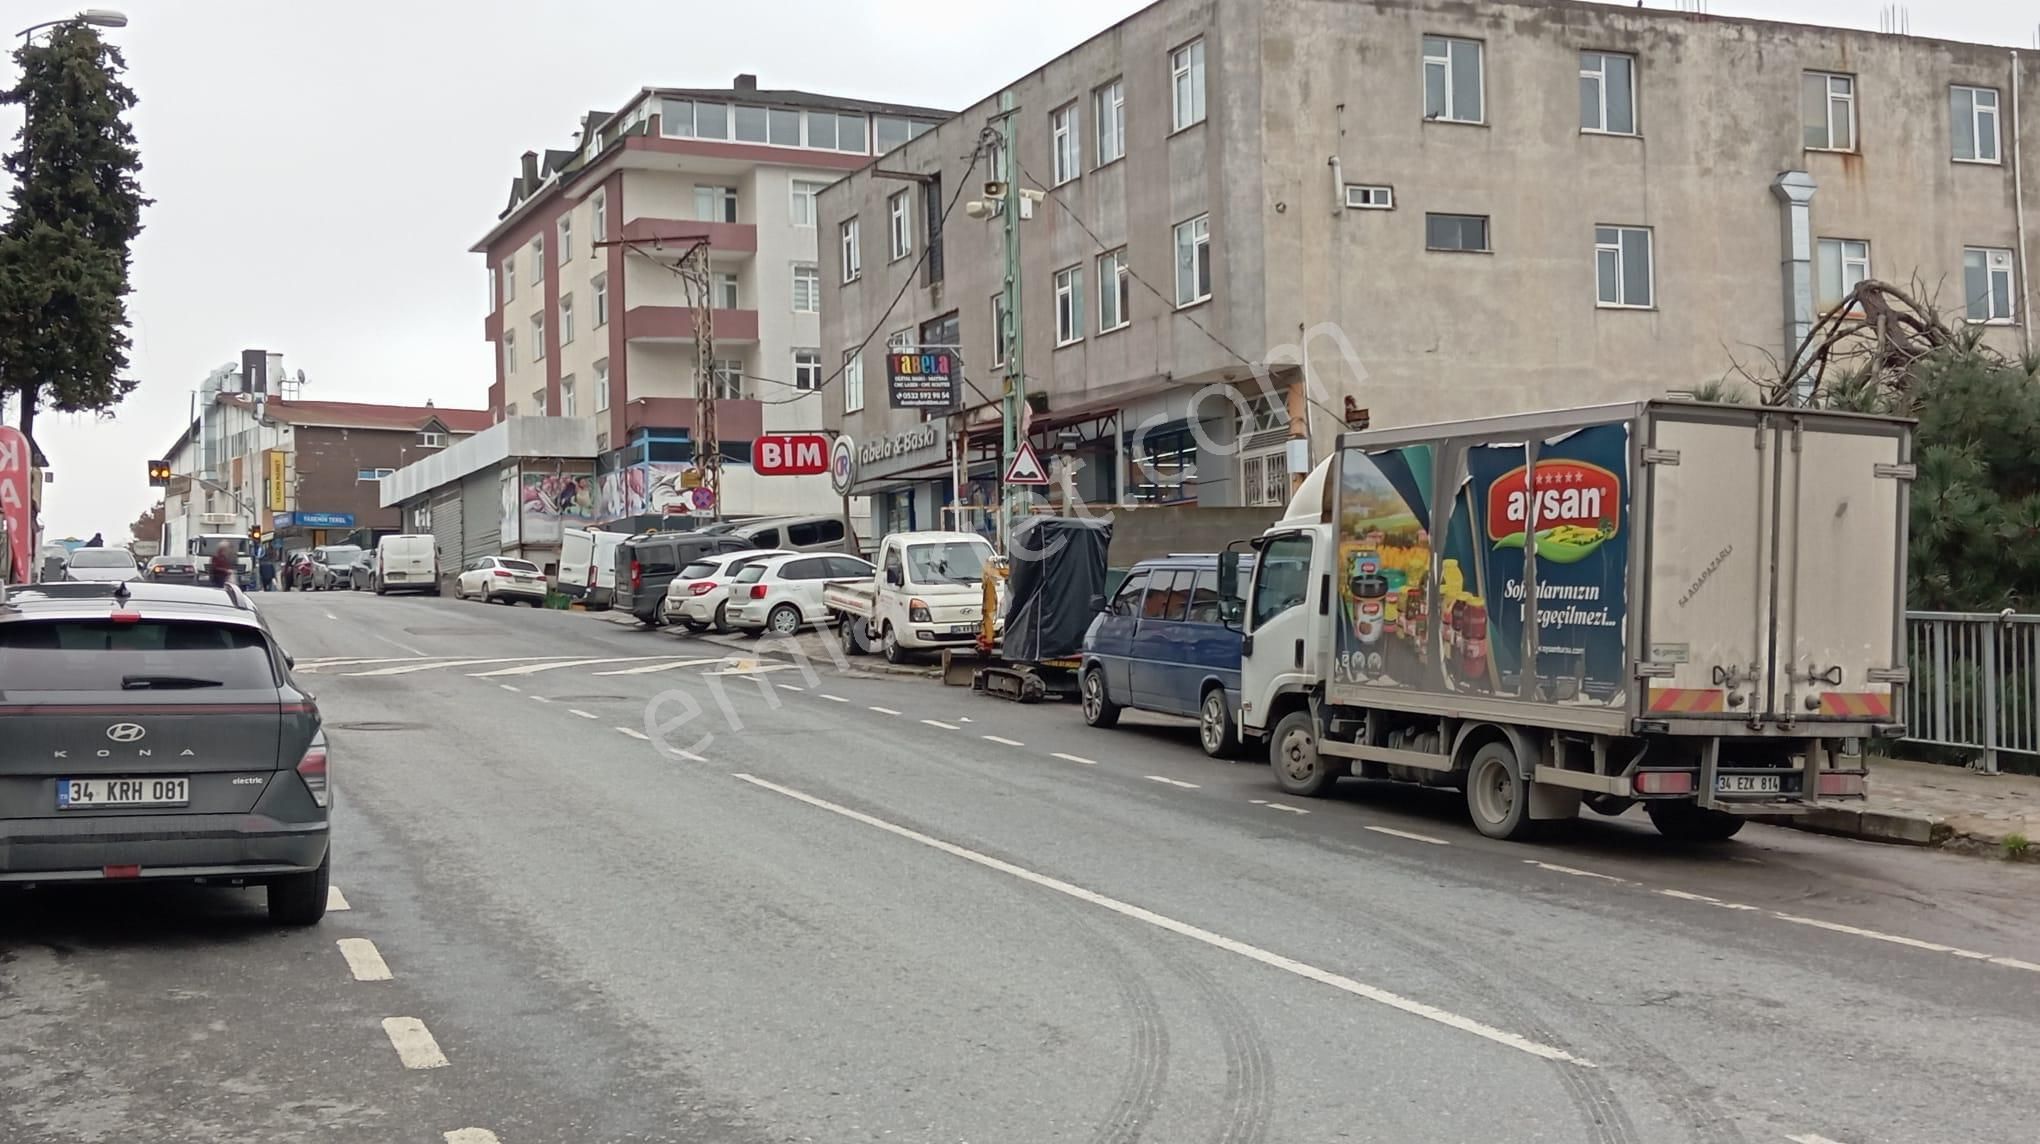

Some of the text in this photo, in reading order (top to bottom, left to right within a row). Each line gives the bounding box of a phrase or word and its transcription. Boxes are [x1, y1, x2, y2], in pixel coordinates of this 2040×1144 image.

[761, 437, 822, 468] BİM
[1507, 487, 1600, 528] aysan
[1520, 603, 1616, 629] zgeçilmezi...
[54, 749, 195, 758] KONA
[71, 782, 94, 802] 34
[107, 781, 143, 802] KRH
[152, 780, 185, 800] 081
[232, 776, 263, 785] electric
[1719, 777, 1778, 790] 34 EZK 814
